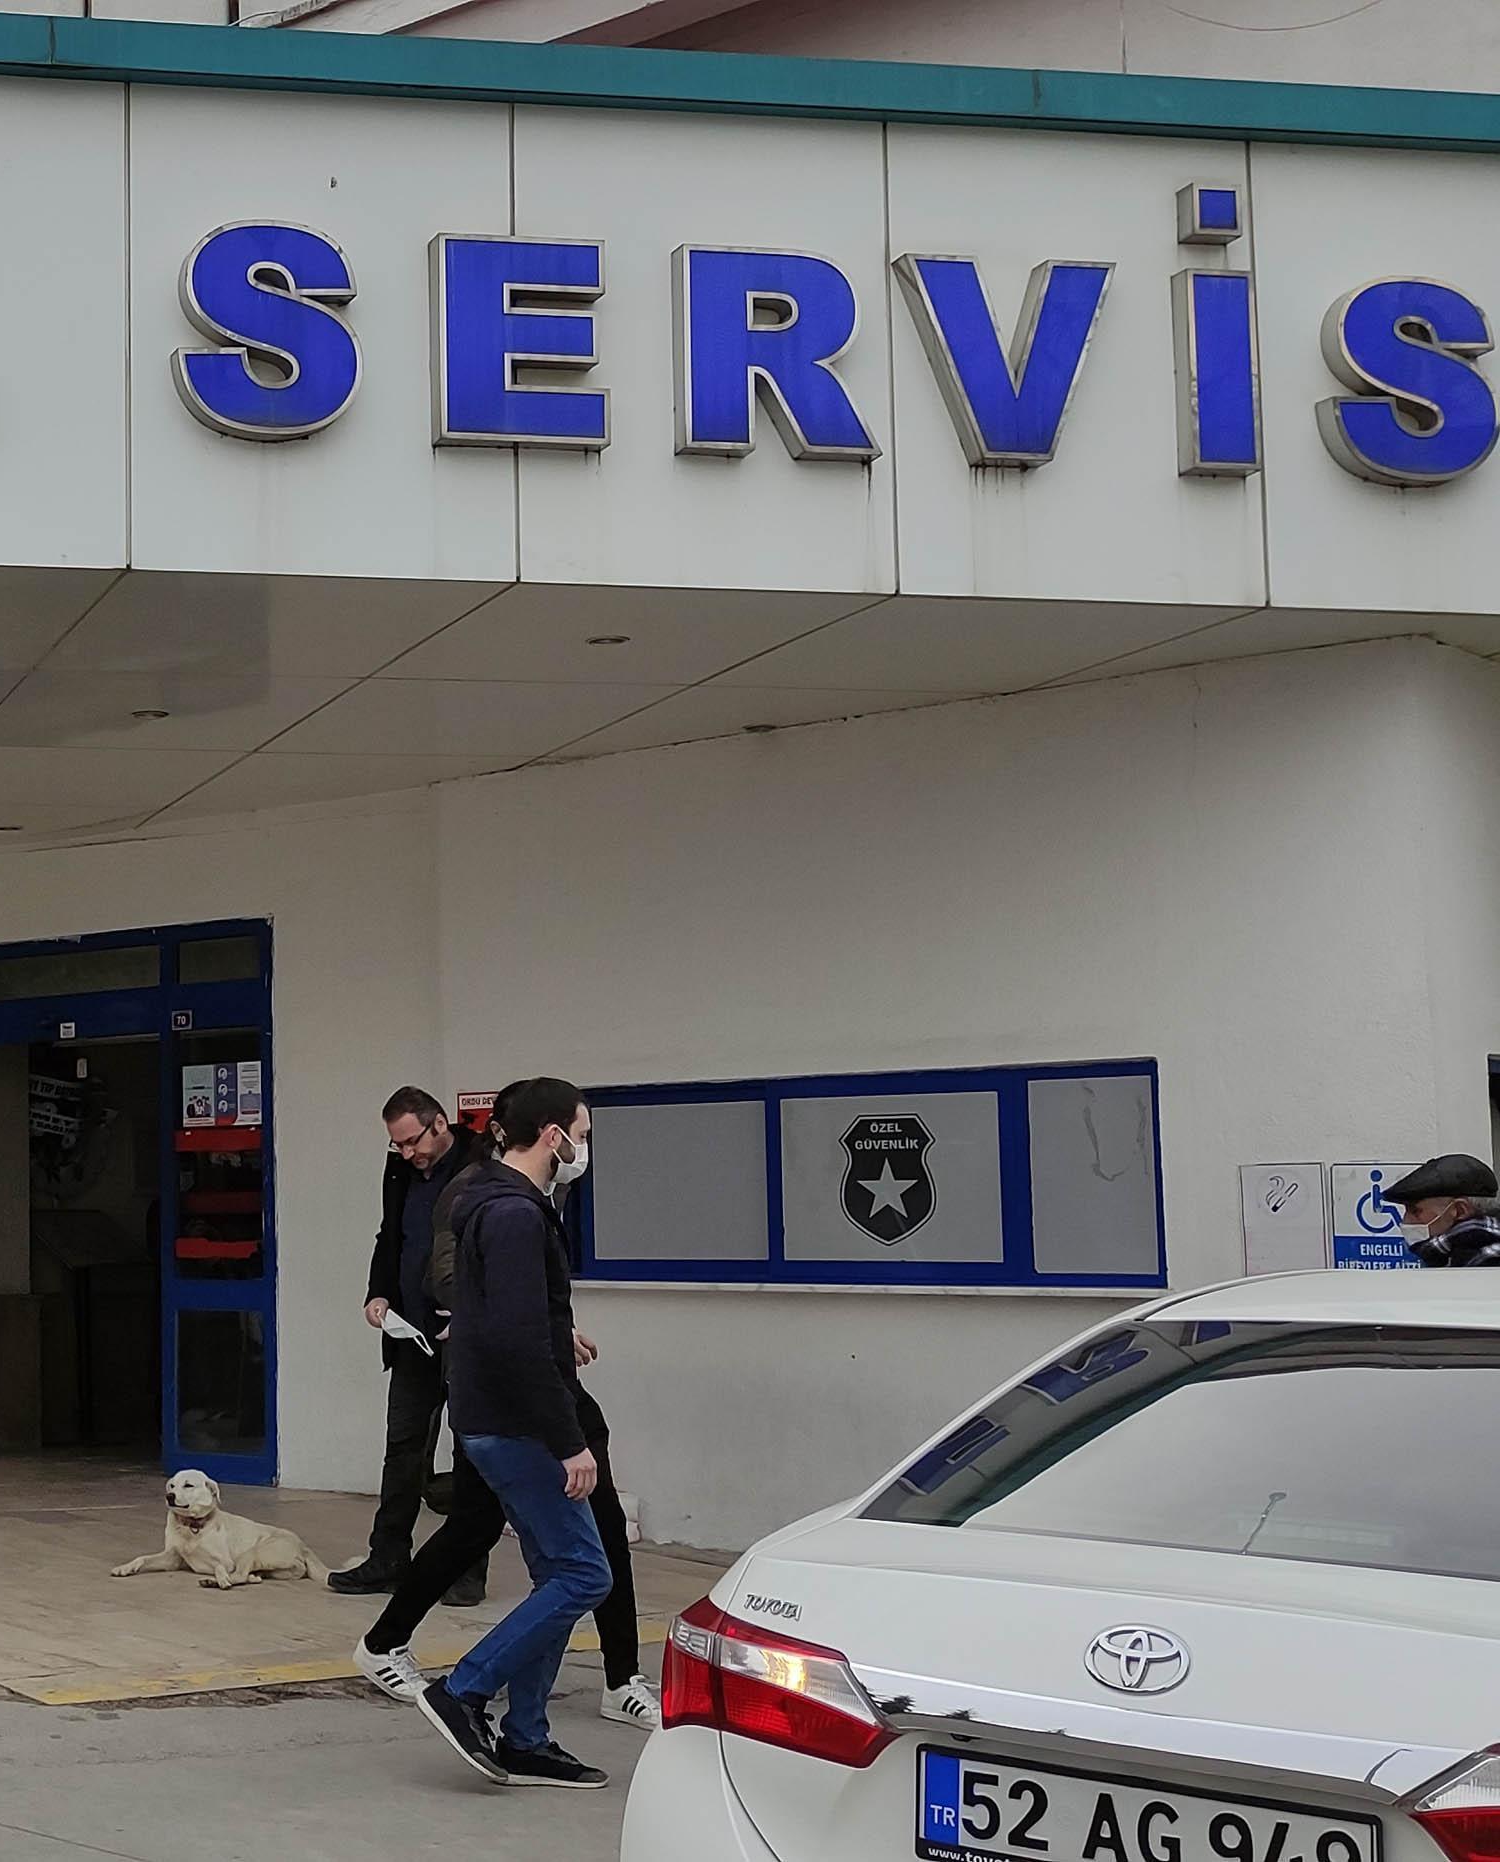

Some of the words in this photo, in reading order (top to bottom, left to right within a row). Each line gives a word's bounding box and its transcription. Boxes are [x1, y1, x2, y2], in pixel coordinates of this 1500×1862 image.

[171, 182, 1500, 488] SERVİS
[175, 1015, 187, 1025] 70
[869, 1121, 902, 1133] ÖZEL
[854, 1137, 919, 1150] GÜVENLİK
[1360, 1242, 1404, 1257] ENGELLİ
[743, 1593, 802, 1621] TOYOTA
[929, 1804, 956, 1828] TR
[961, 1770, 1050, 1852] 52
[1082, 1792, 1182, 1862] AG
